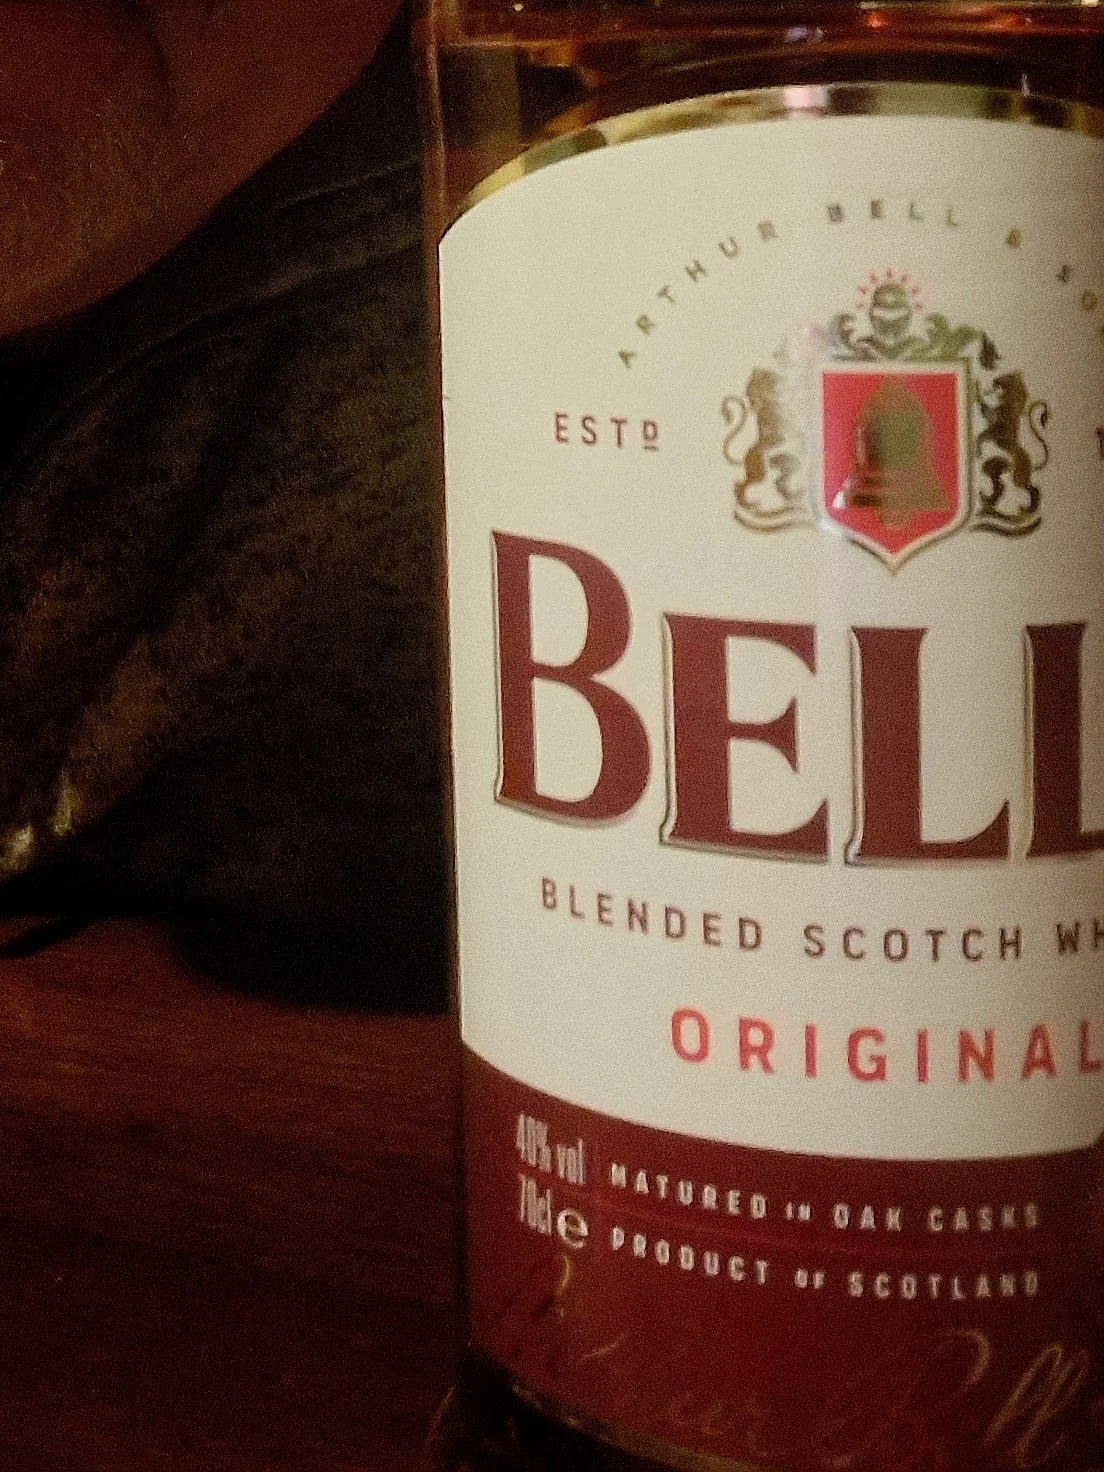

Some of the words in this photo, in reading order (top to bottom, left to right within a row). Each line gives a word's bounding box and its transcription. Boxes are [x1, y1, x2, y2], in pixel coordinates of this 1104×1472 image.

[617, 220, 779, 369] ARTHUR
[827, 199, 960, 227] BELL
[540, 876, 764, 952] BLENDED
[802, 923, 1023, 962] SCOTCH
[669, 1006, 1104, 1083] ORIGINAL
[610, 1163, 768, 1220] MATURED
[832, 1201, 903, 1232] OAK
[927, 1201, 1041, 1233] CASKS
[610, 1225, 770, 1286] PRODUCT
[846, 1268, 1040, 1301] SCOTLAND
